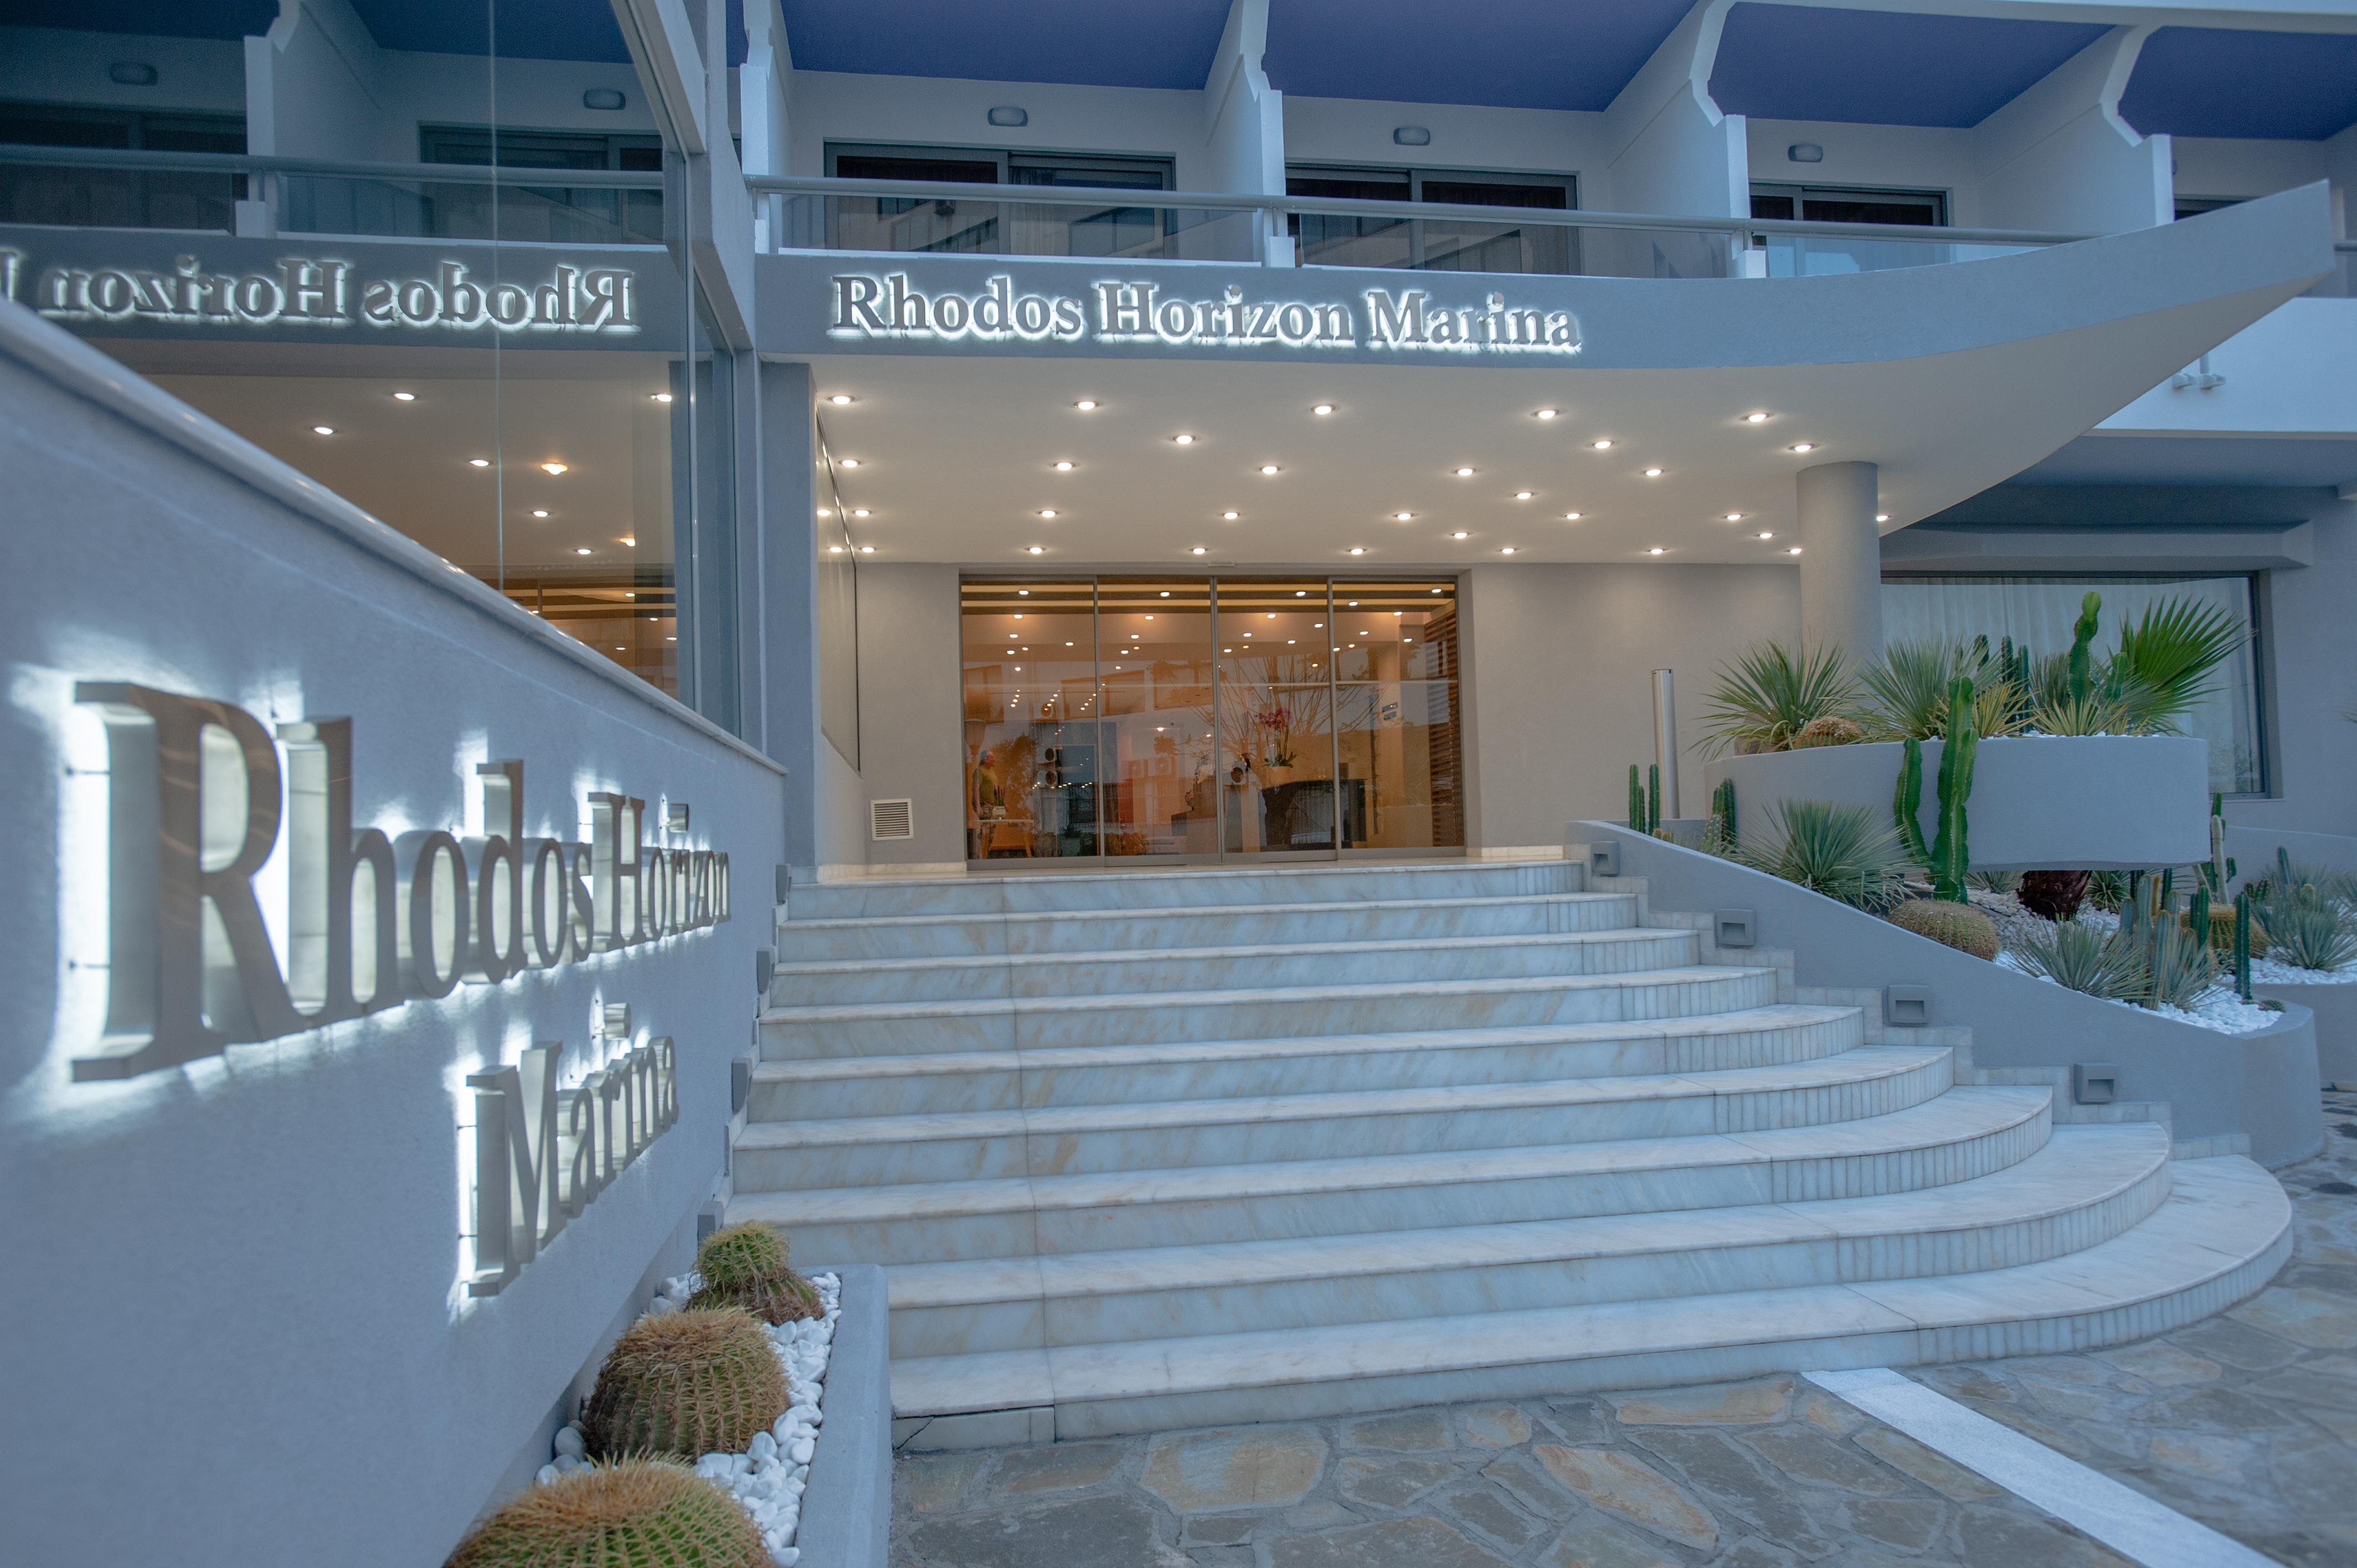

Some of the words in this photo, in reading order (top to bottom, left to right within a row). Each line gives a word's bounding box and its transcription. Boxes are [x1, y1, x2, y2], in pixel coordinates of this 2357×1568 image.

[832, 274, 1082, 338] Rhodos
[1098, 281, 1356, 345] Horizon
[1368, 288, 1583, 348] Marina
[72, 681, 595, 1082] Rhodos
[587, 791, 732, 953] Horizon
[465, 1001, 679, 1297] Marina
